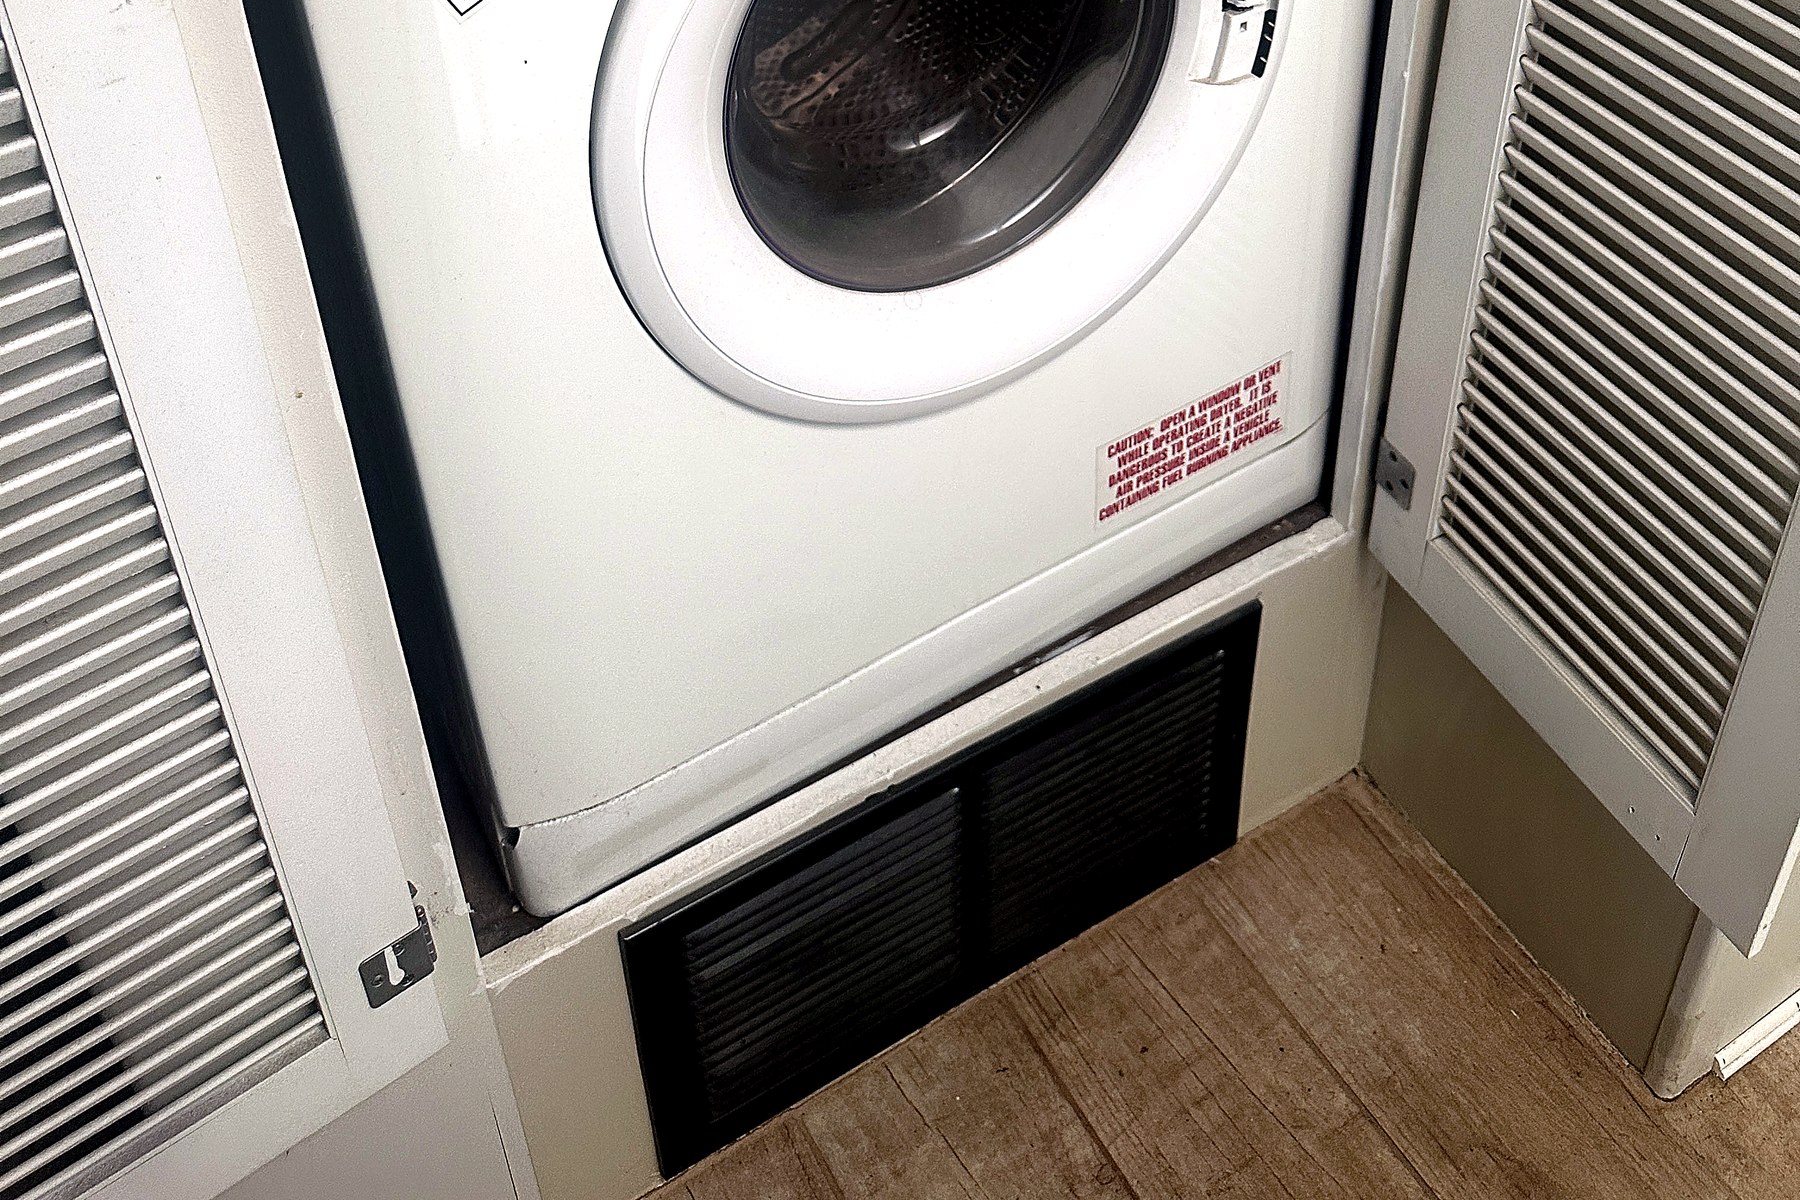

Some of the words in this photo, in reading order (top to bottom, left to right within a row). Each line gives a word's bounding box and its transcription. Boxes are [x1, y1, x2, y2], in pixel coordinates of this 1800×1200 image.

[1107, 426, 1154, 458] CAUTION:
[1160, 409, 1186, 431] OPEN
[1188, 405, 1195, 418] A
[1198, 381, 1241, 413] WINDOW
[1243, 374, 1256, 390] OR
[1259, 360, 1281, 382] VENT
[1108, 448, 1168, 487] DANGEROUS
[1172, 439, 1183, 455] TO
[1186, 420, 1221, 448] CREATE
[1224, 416, 1231, 428] A
[1233, 390, 1278, 423] NEGATIVE
[1116, 480, 1133, 498] AIR
[1136, 452, 1186, 488] PRESSURE
[1188, 434, 1221, 461] INSIDE
[1223, 431, 1230, 443] A
[1233, 409, 1270, 437] VEHICLE
[1117, 442, 1150, 468] WHILE
[1152, 413, 1207, 450] OPERATING
[1210, 397, 1243, 422] DRYER.
[1249, 386, 1259, 401] IT
[1261, 380, 1271, 395] IS
[1098, 480, 1160, 521] CONTAINING
[1162, 469, 1183, 488] FUEL
[1186, 444, 1229, 476] BURNING
[1231, 417, 1283, 452] APPLIANCE.
